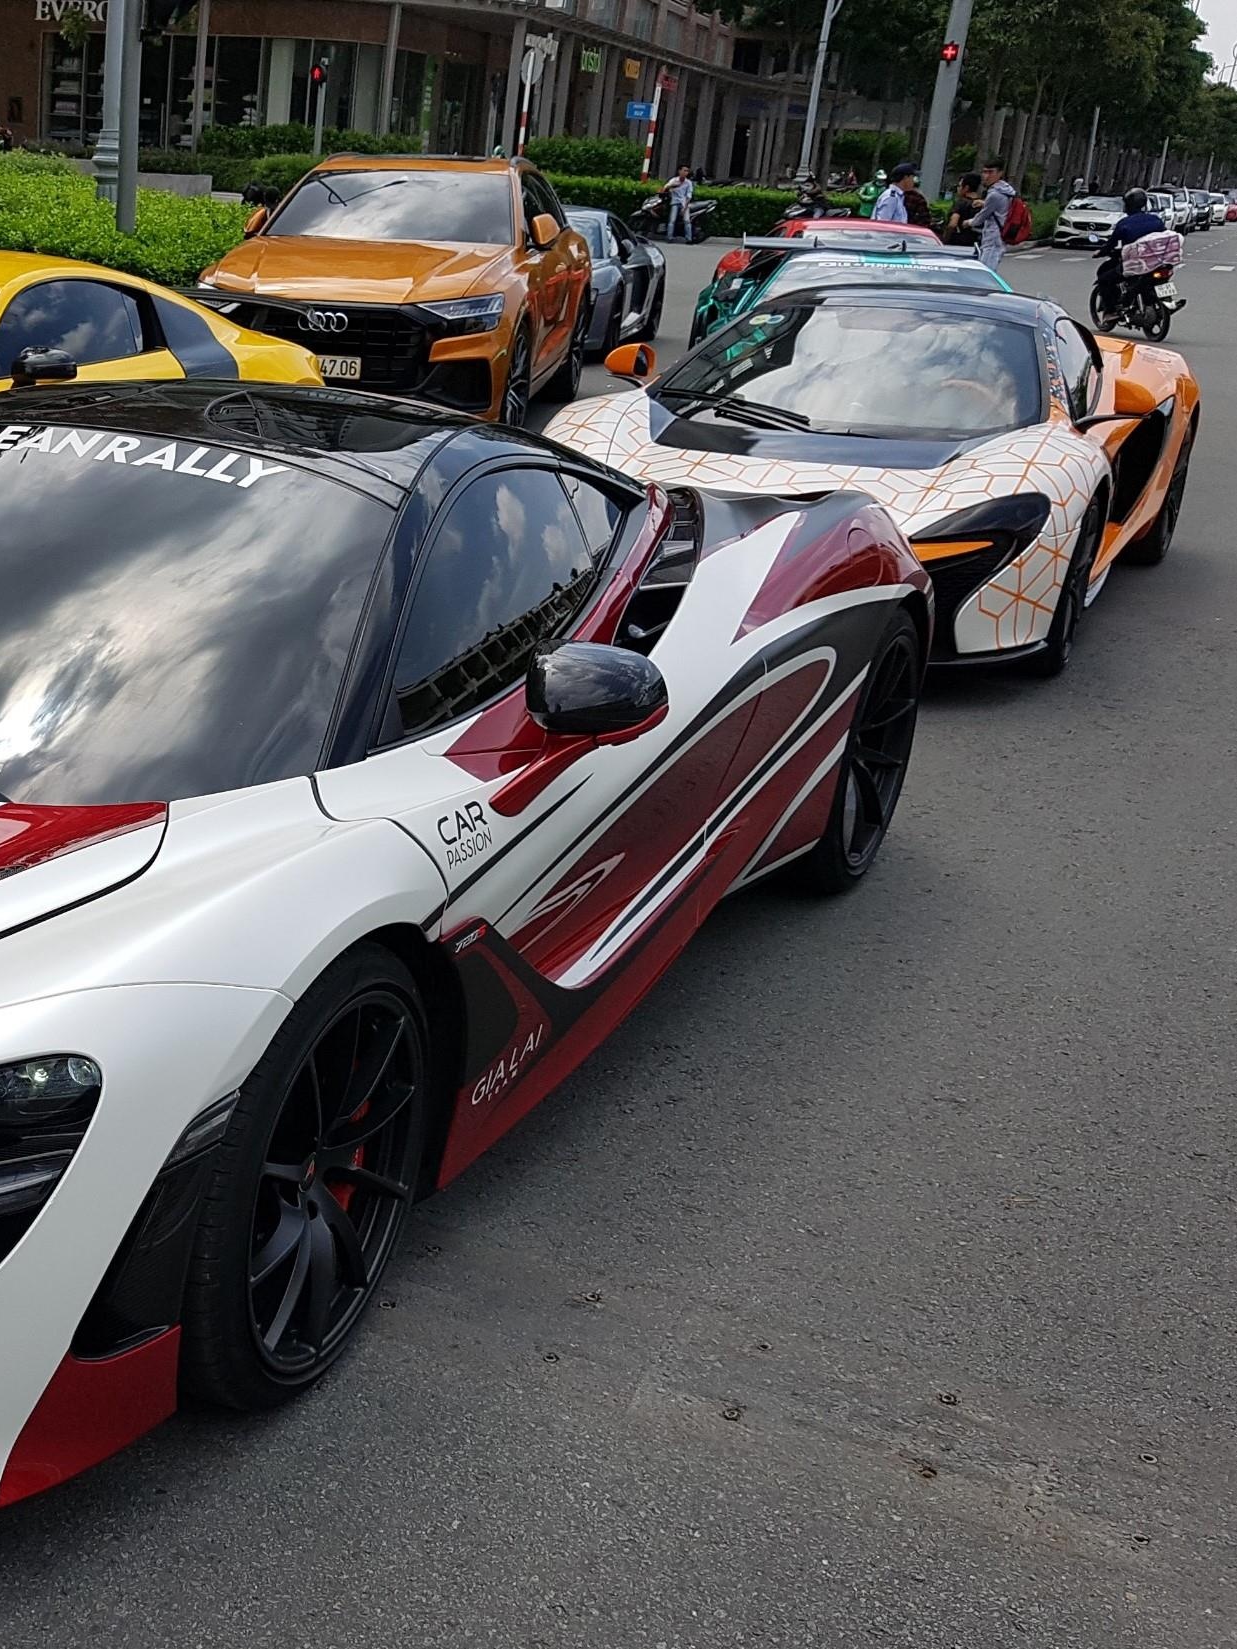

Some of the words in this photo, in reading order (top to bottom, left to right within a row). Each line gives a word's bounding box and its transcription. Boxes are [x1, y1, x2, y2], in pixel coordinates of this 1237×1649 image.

[437, 801, 489, 845] CAR
[446, 827, 492, 870] PASSION
[454, 924, 487, 954] 720S
